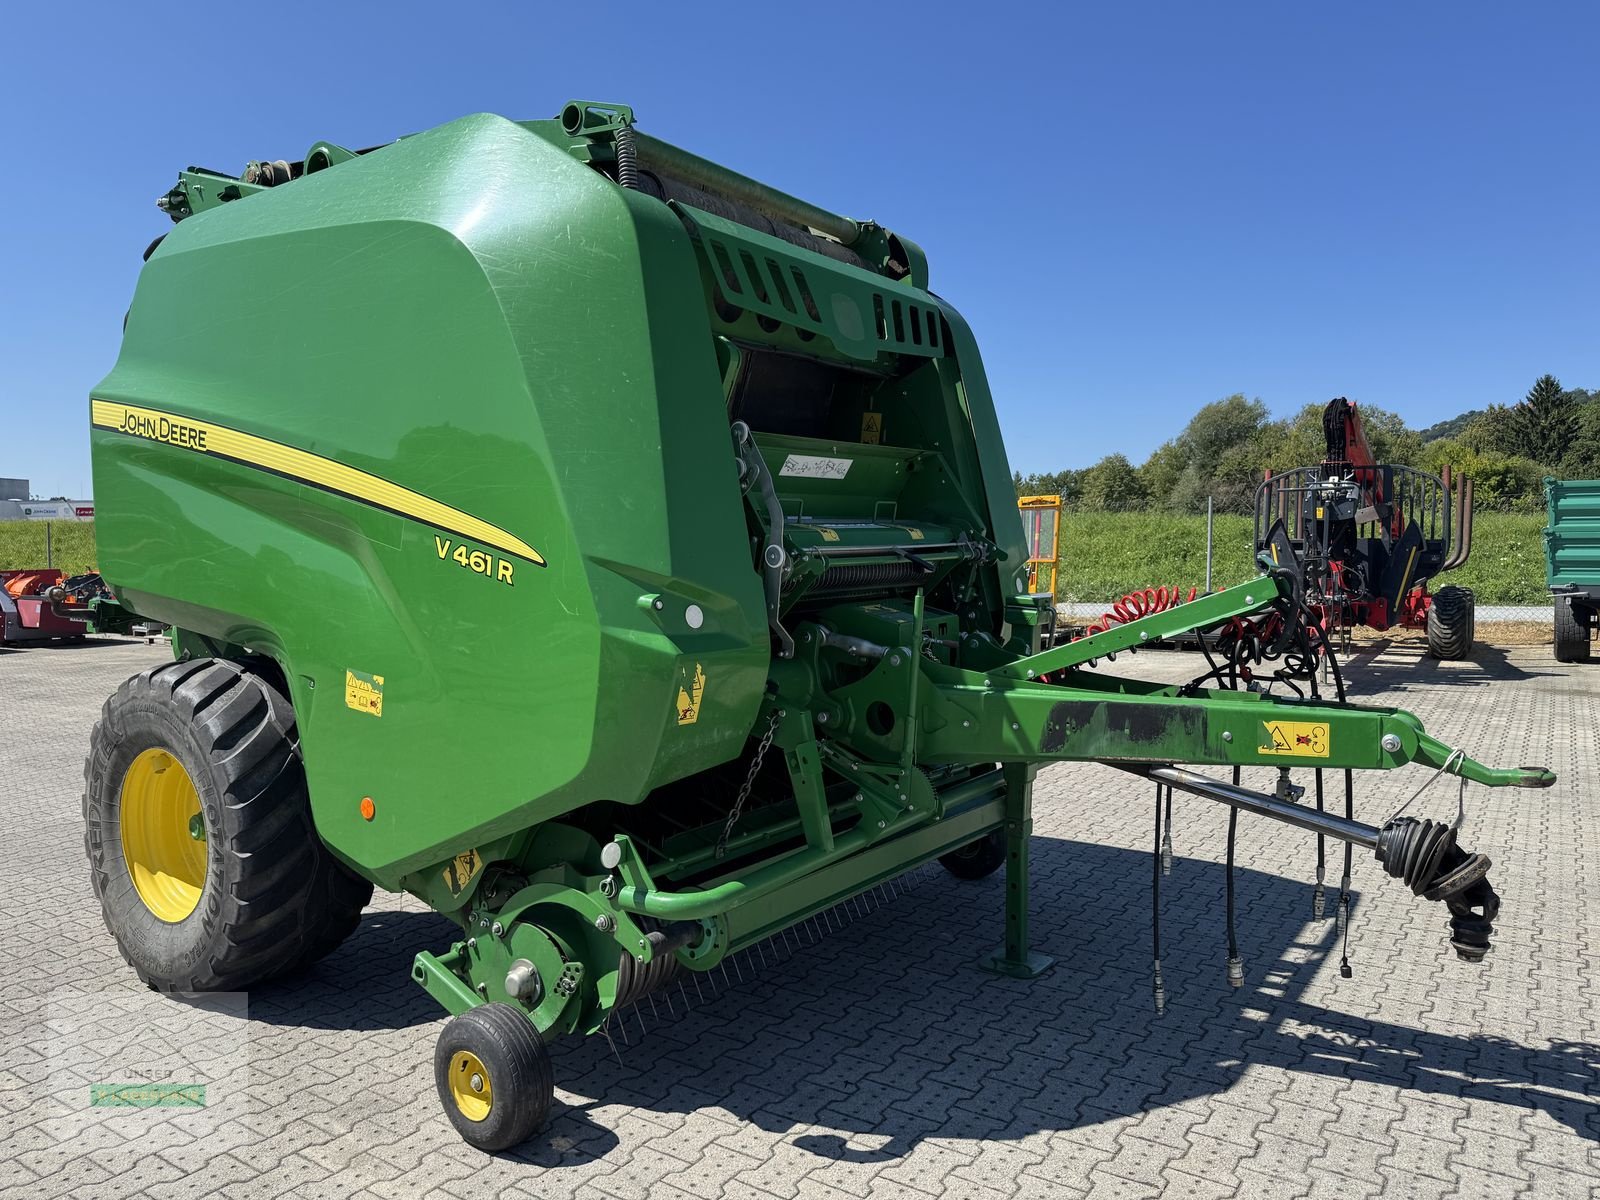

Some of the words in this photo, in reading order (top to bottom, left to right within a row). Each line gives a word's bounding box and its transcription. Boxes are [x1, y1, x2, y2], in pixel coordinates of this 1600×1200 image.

[119, 409, 156, 437] JOHN
[159, 417, 207, 449] DEERE
[434, 534, 452, 561] V
[452, 543, 493, 578] 461
[496, 557, 514, 587] R
[194, 769, 226, 940] FLOTATION
[183, 937, 208, 968] TRAC
